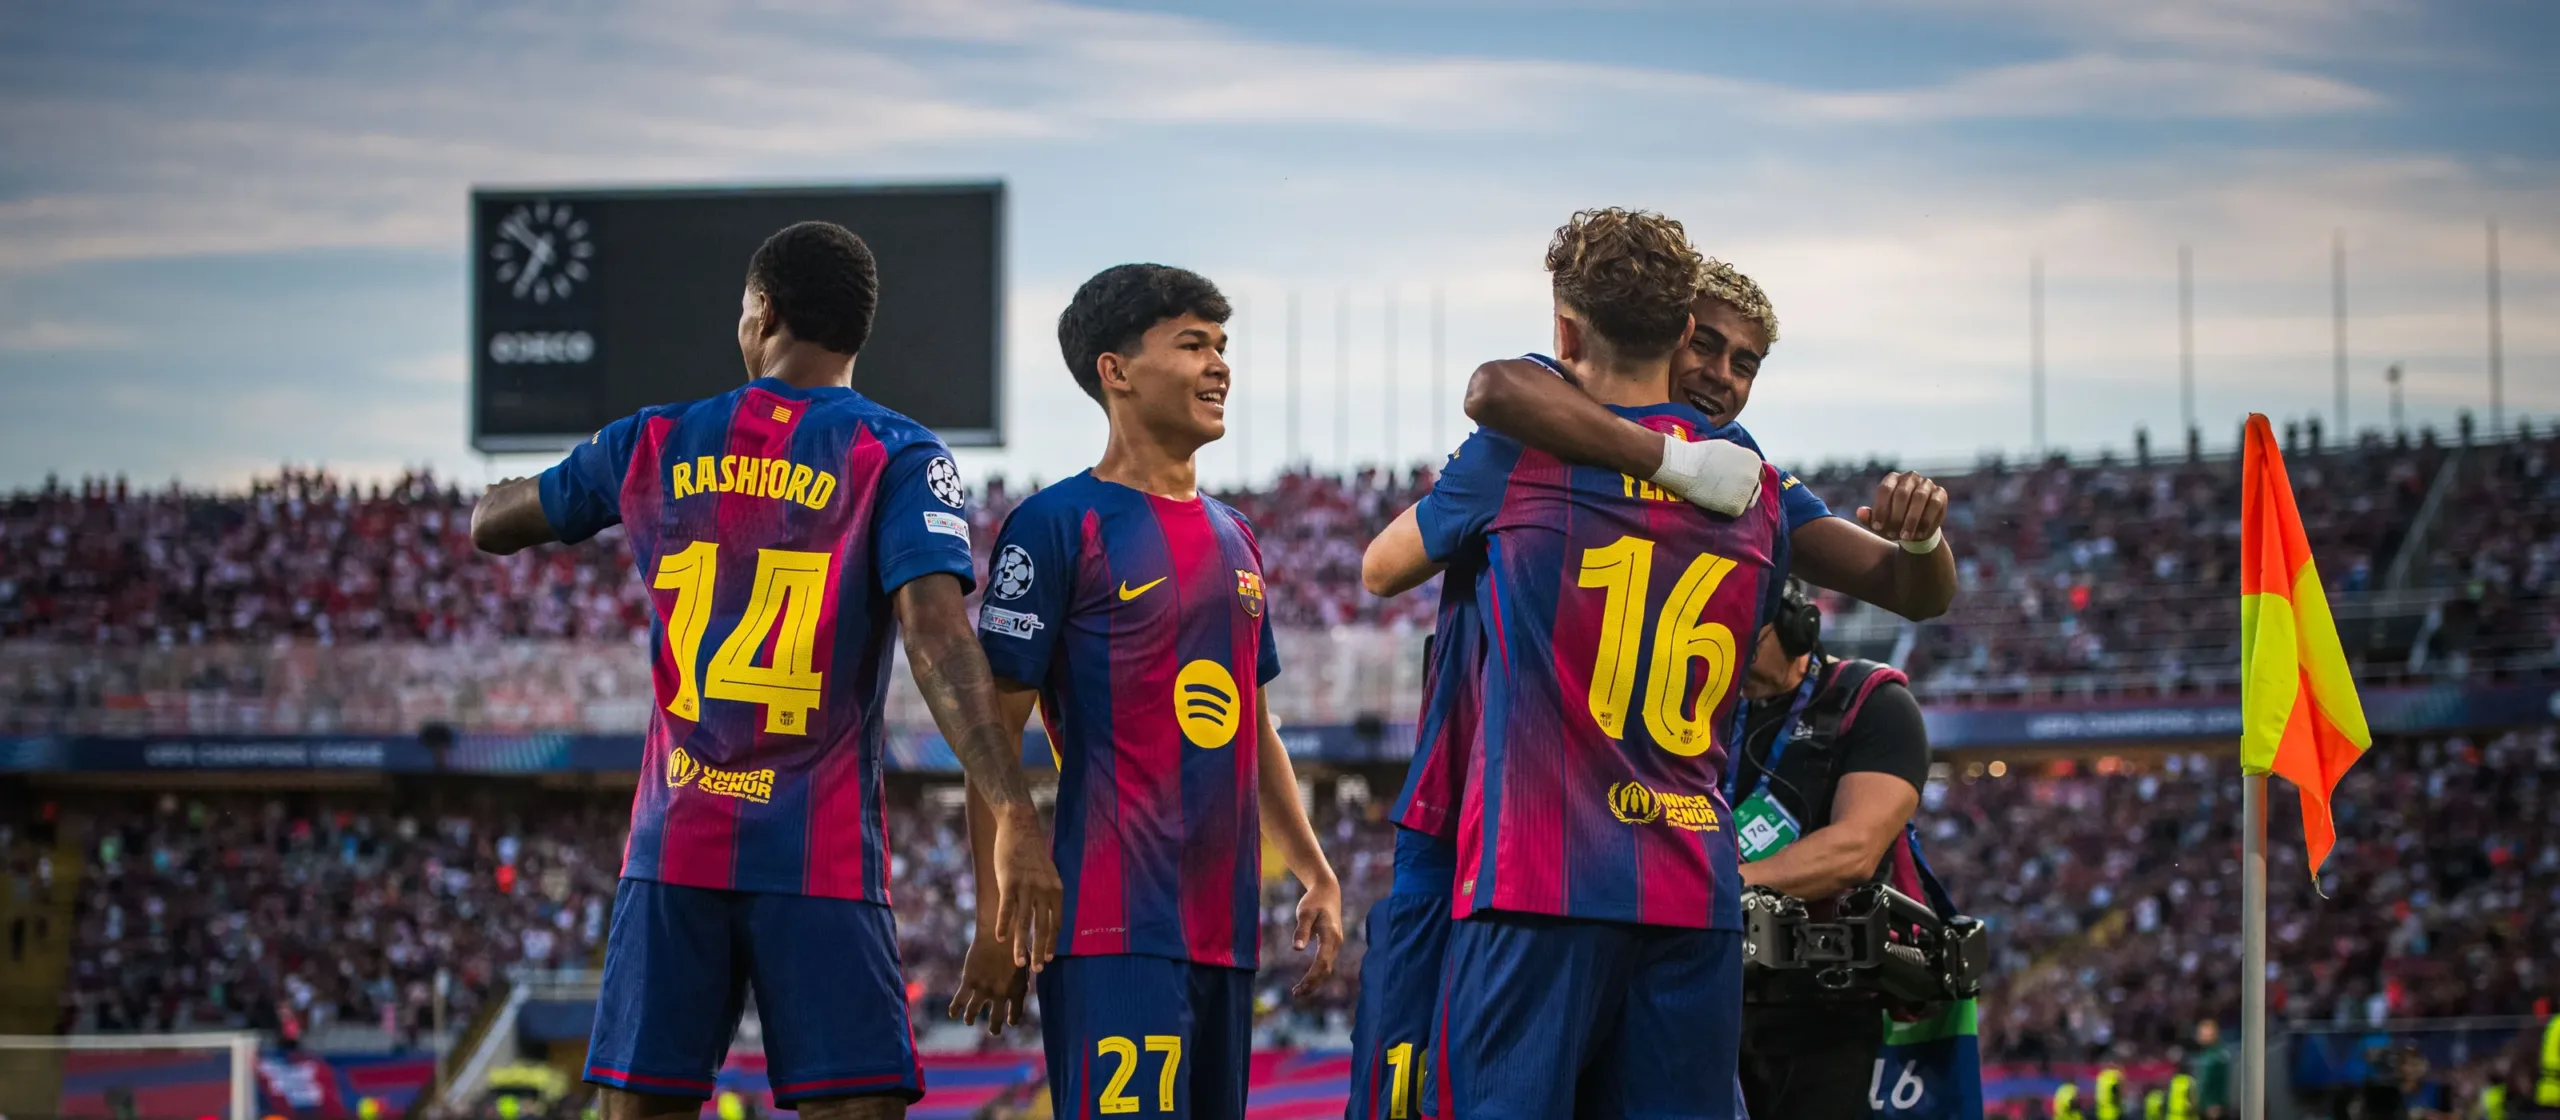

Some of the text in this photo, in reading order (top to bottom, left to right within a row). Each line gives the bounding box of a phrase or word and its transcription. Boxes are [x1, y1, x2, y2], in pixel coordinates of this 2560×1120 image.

[673, 455, 836, 510] RASHFORD
[653, 541, 832, 735] 14
[1578, 535, 1738, 757] 16
[699, 776, 772, 799] ACNUR
[704, 766, 775, 785] UNHCR
[1098, 1035, 1181, 1114] 27
